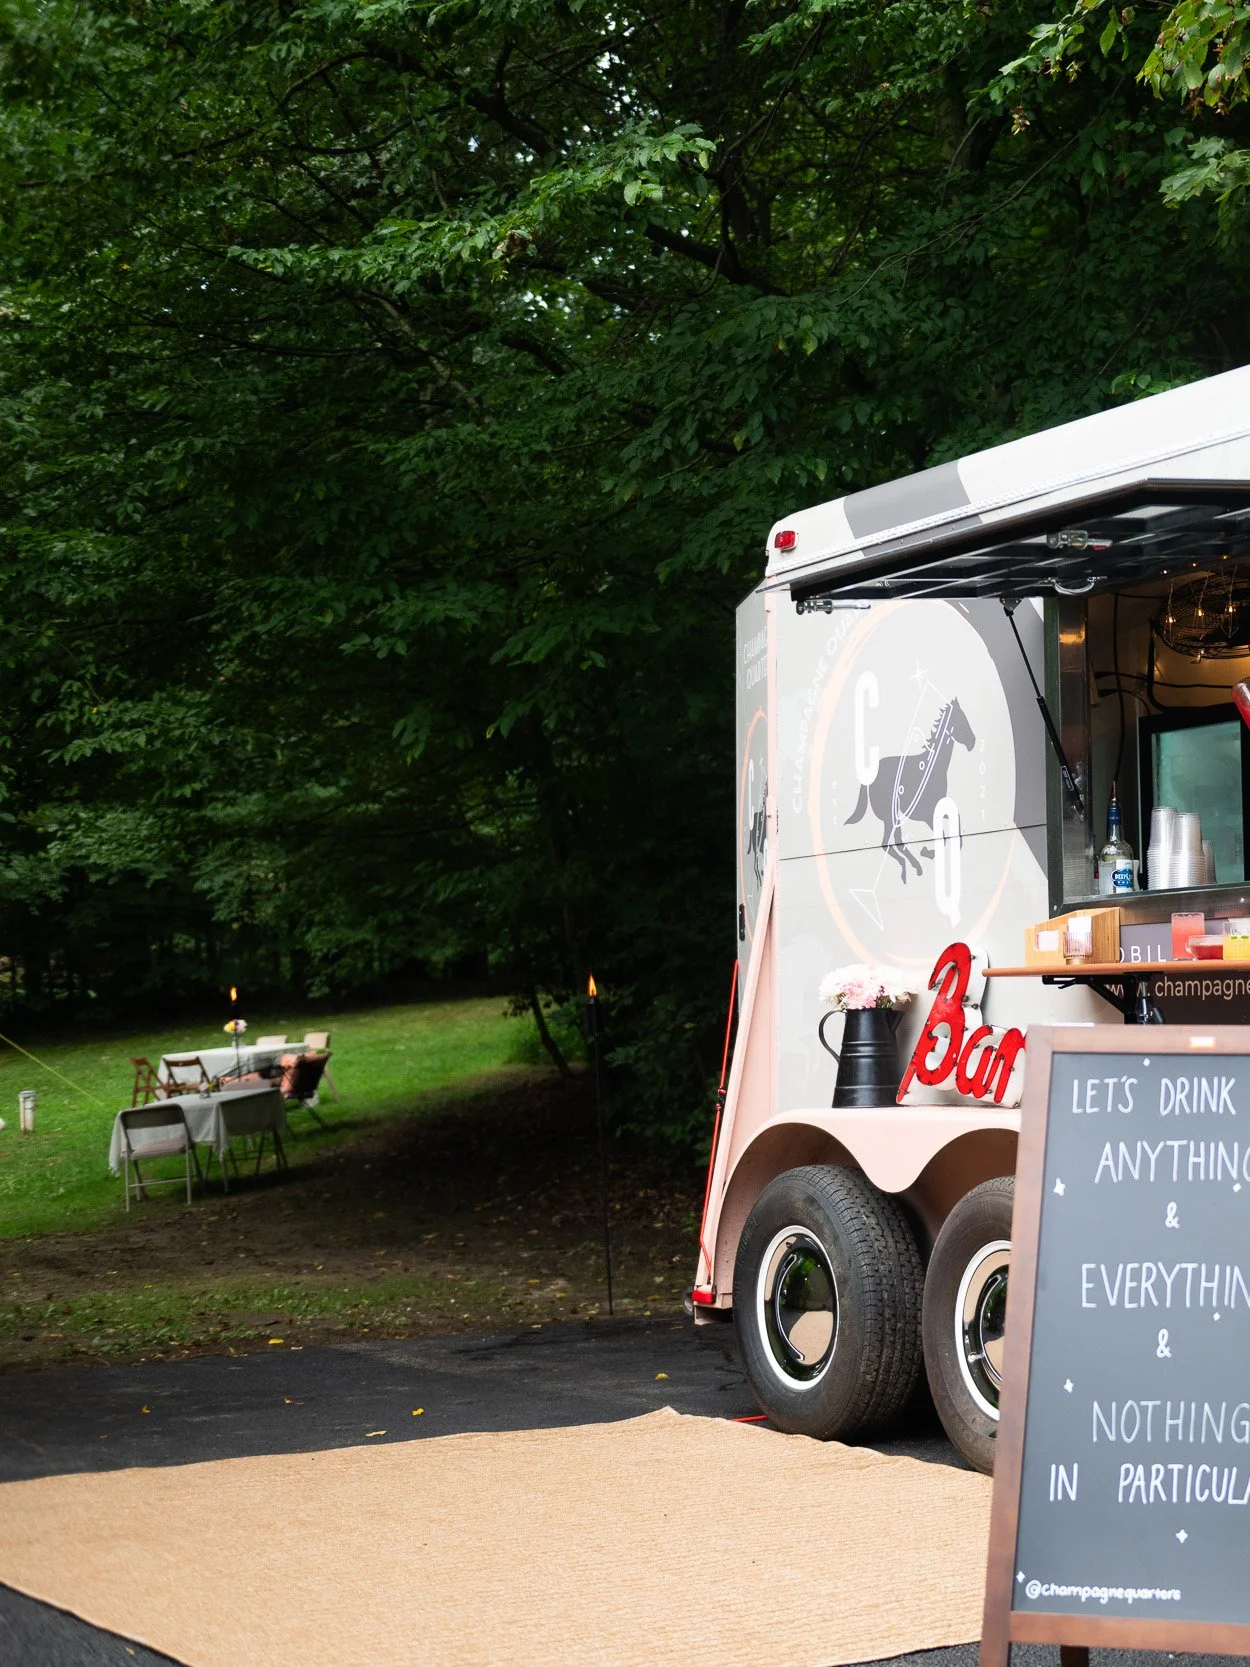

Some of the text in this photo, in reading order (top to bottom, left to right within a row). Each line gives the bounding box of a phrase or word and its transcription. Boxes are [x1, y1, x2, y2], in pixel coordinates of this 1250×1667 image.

[896, 942, 1026, 1104] Bar
[1071, 1075, 1139, 1114] LET'S
[1159, 1076, 1237, 1117] DRINK
[1164, 1201, 1181, 1229] &
[1156, 1328, 1172, 1359] &
[1049, 1462, 1079, 1503] IN
